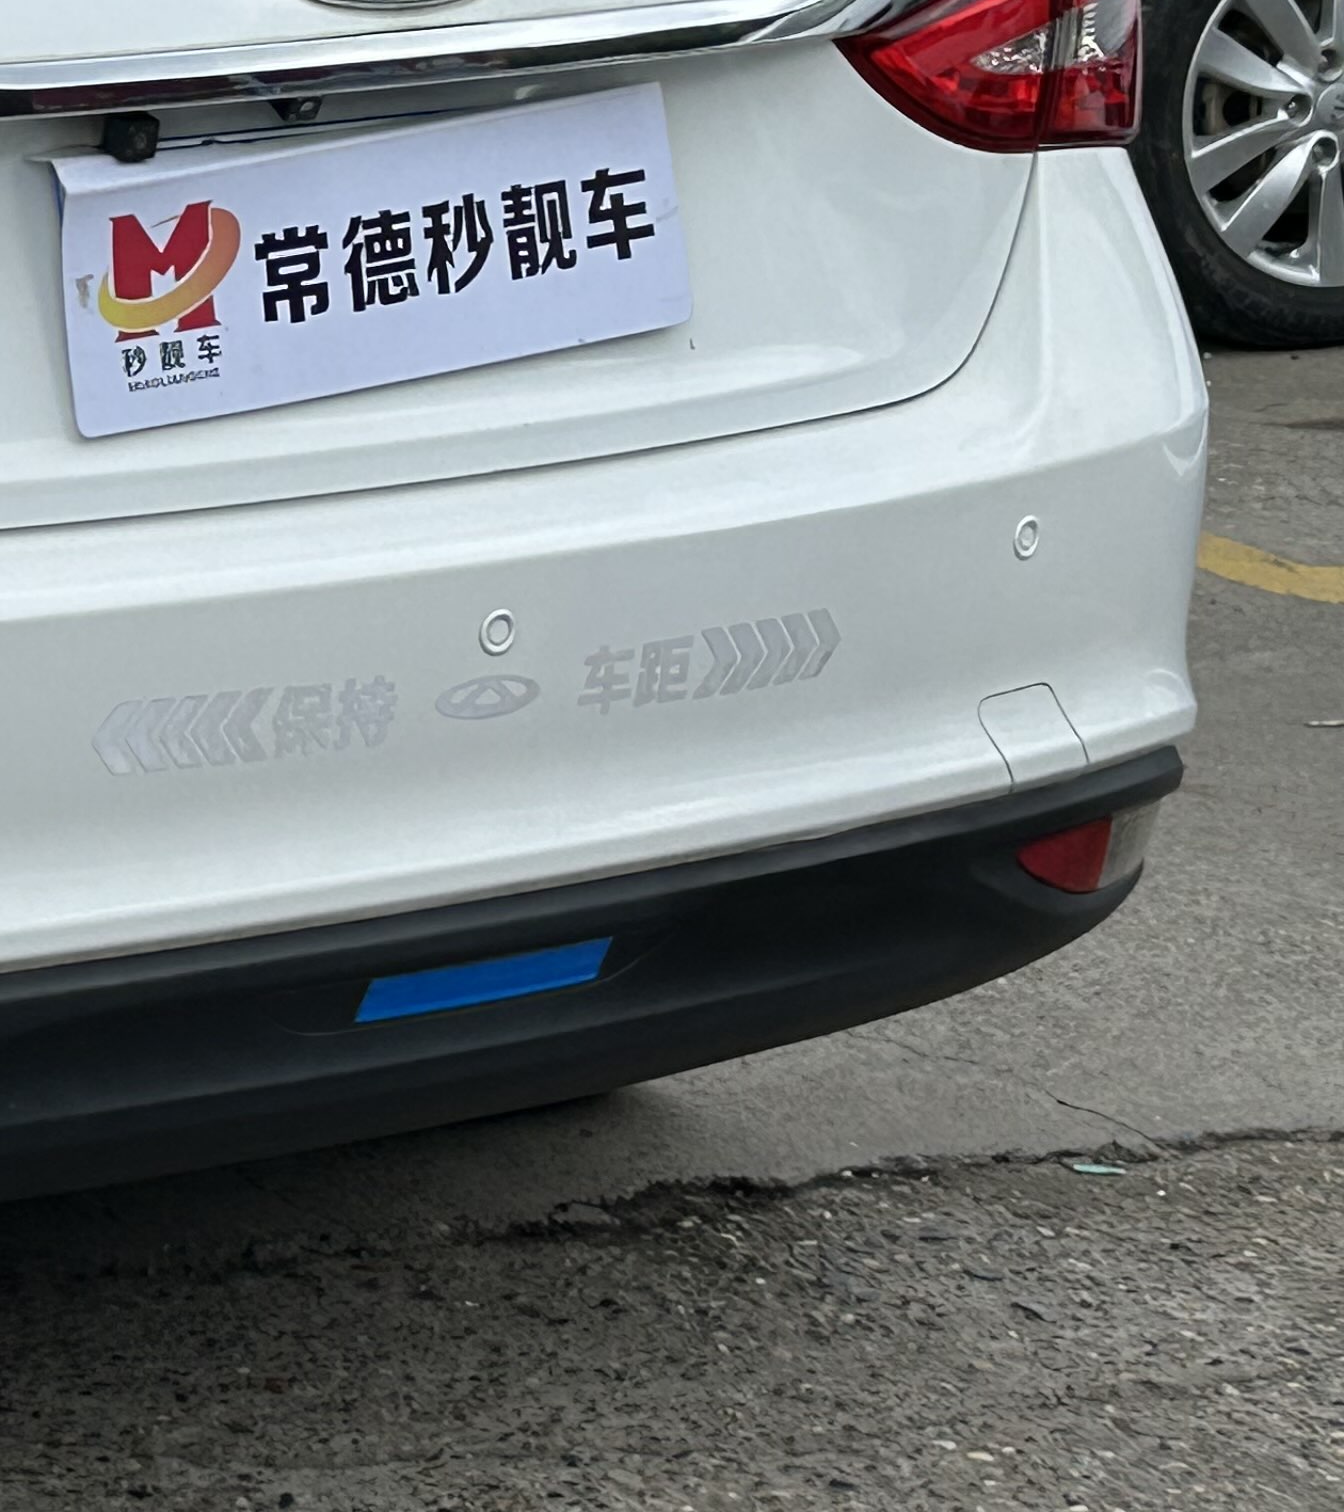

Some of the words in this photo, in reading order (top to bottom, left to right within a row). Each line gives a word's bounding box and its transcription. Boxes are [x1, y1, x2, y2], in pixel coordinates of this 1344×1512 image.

[253, 167, 657, 324] 常德秒靓车
[271, 675, 399, 757] 保持
[577, 634, 697, 715] 车距
